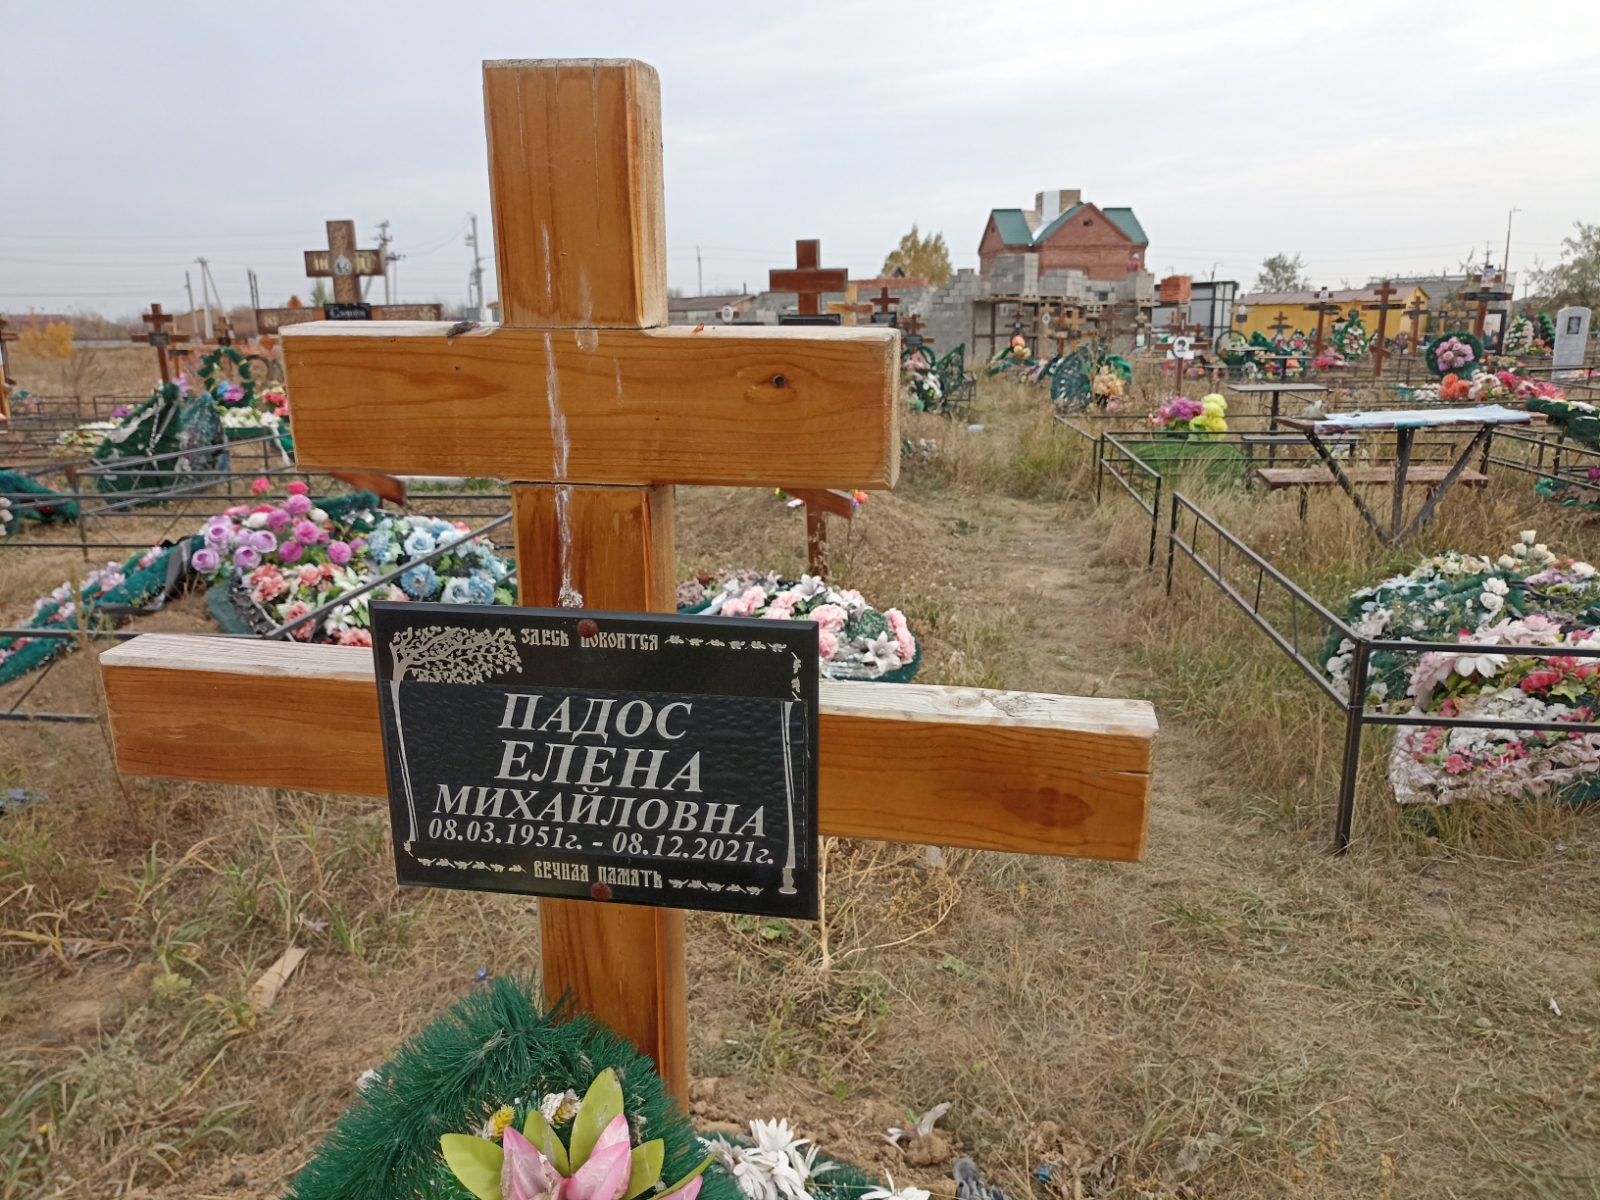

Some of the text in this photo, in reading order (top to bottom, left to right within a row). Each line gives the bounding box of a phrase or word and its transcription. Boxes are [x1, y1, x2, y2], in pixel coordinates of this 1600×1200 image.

[521, 629, 569, 646] ЗДЕСЬ
[498, 693, 692, 742] ПАДОС
[494, 740, 702, 792] ЕЛЕНА
[432, 784, 766, 836] МИХАЙЛОВНА
[429, 818, 582, 850] 08.03.1951г.
[613, 832, 774, 864] 08.12.2021г.
[534, 861, 663, 888] ВЕЧНАЯ ПАМЯТЬ
